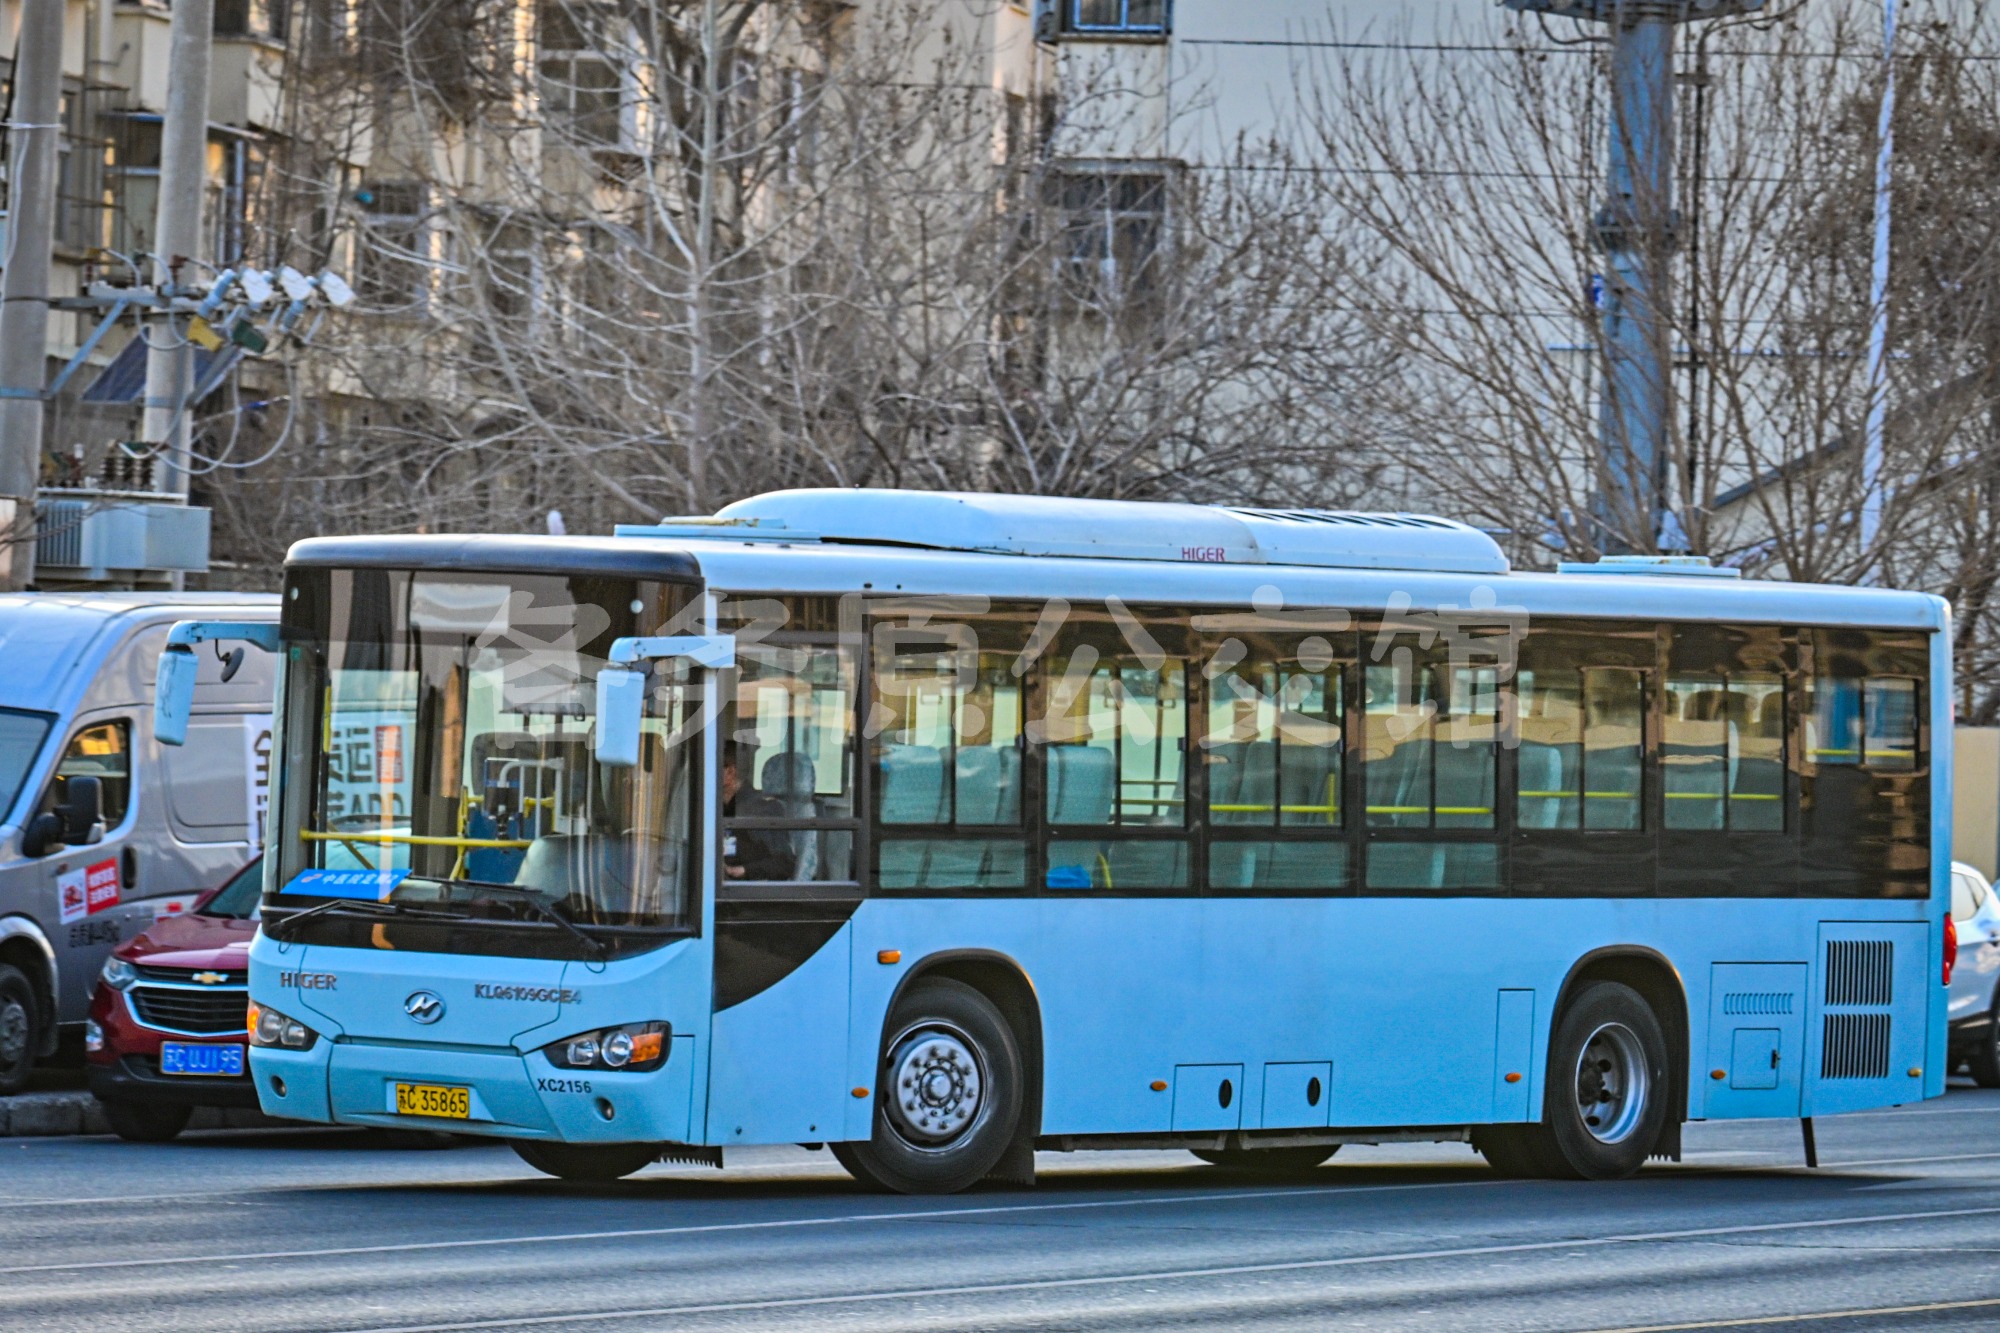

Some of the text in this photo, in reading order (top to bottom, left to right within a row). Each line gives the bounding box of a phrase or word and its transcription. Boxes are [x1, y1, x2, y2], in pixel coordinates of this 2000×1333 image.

[1181, 546, 1226, 562] HIGER
[280, 972, 338, 991] HIGER
[537, 1078, 592, 1094] XC2156
